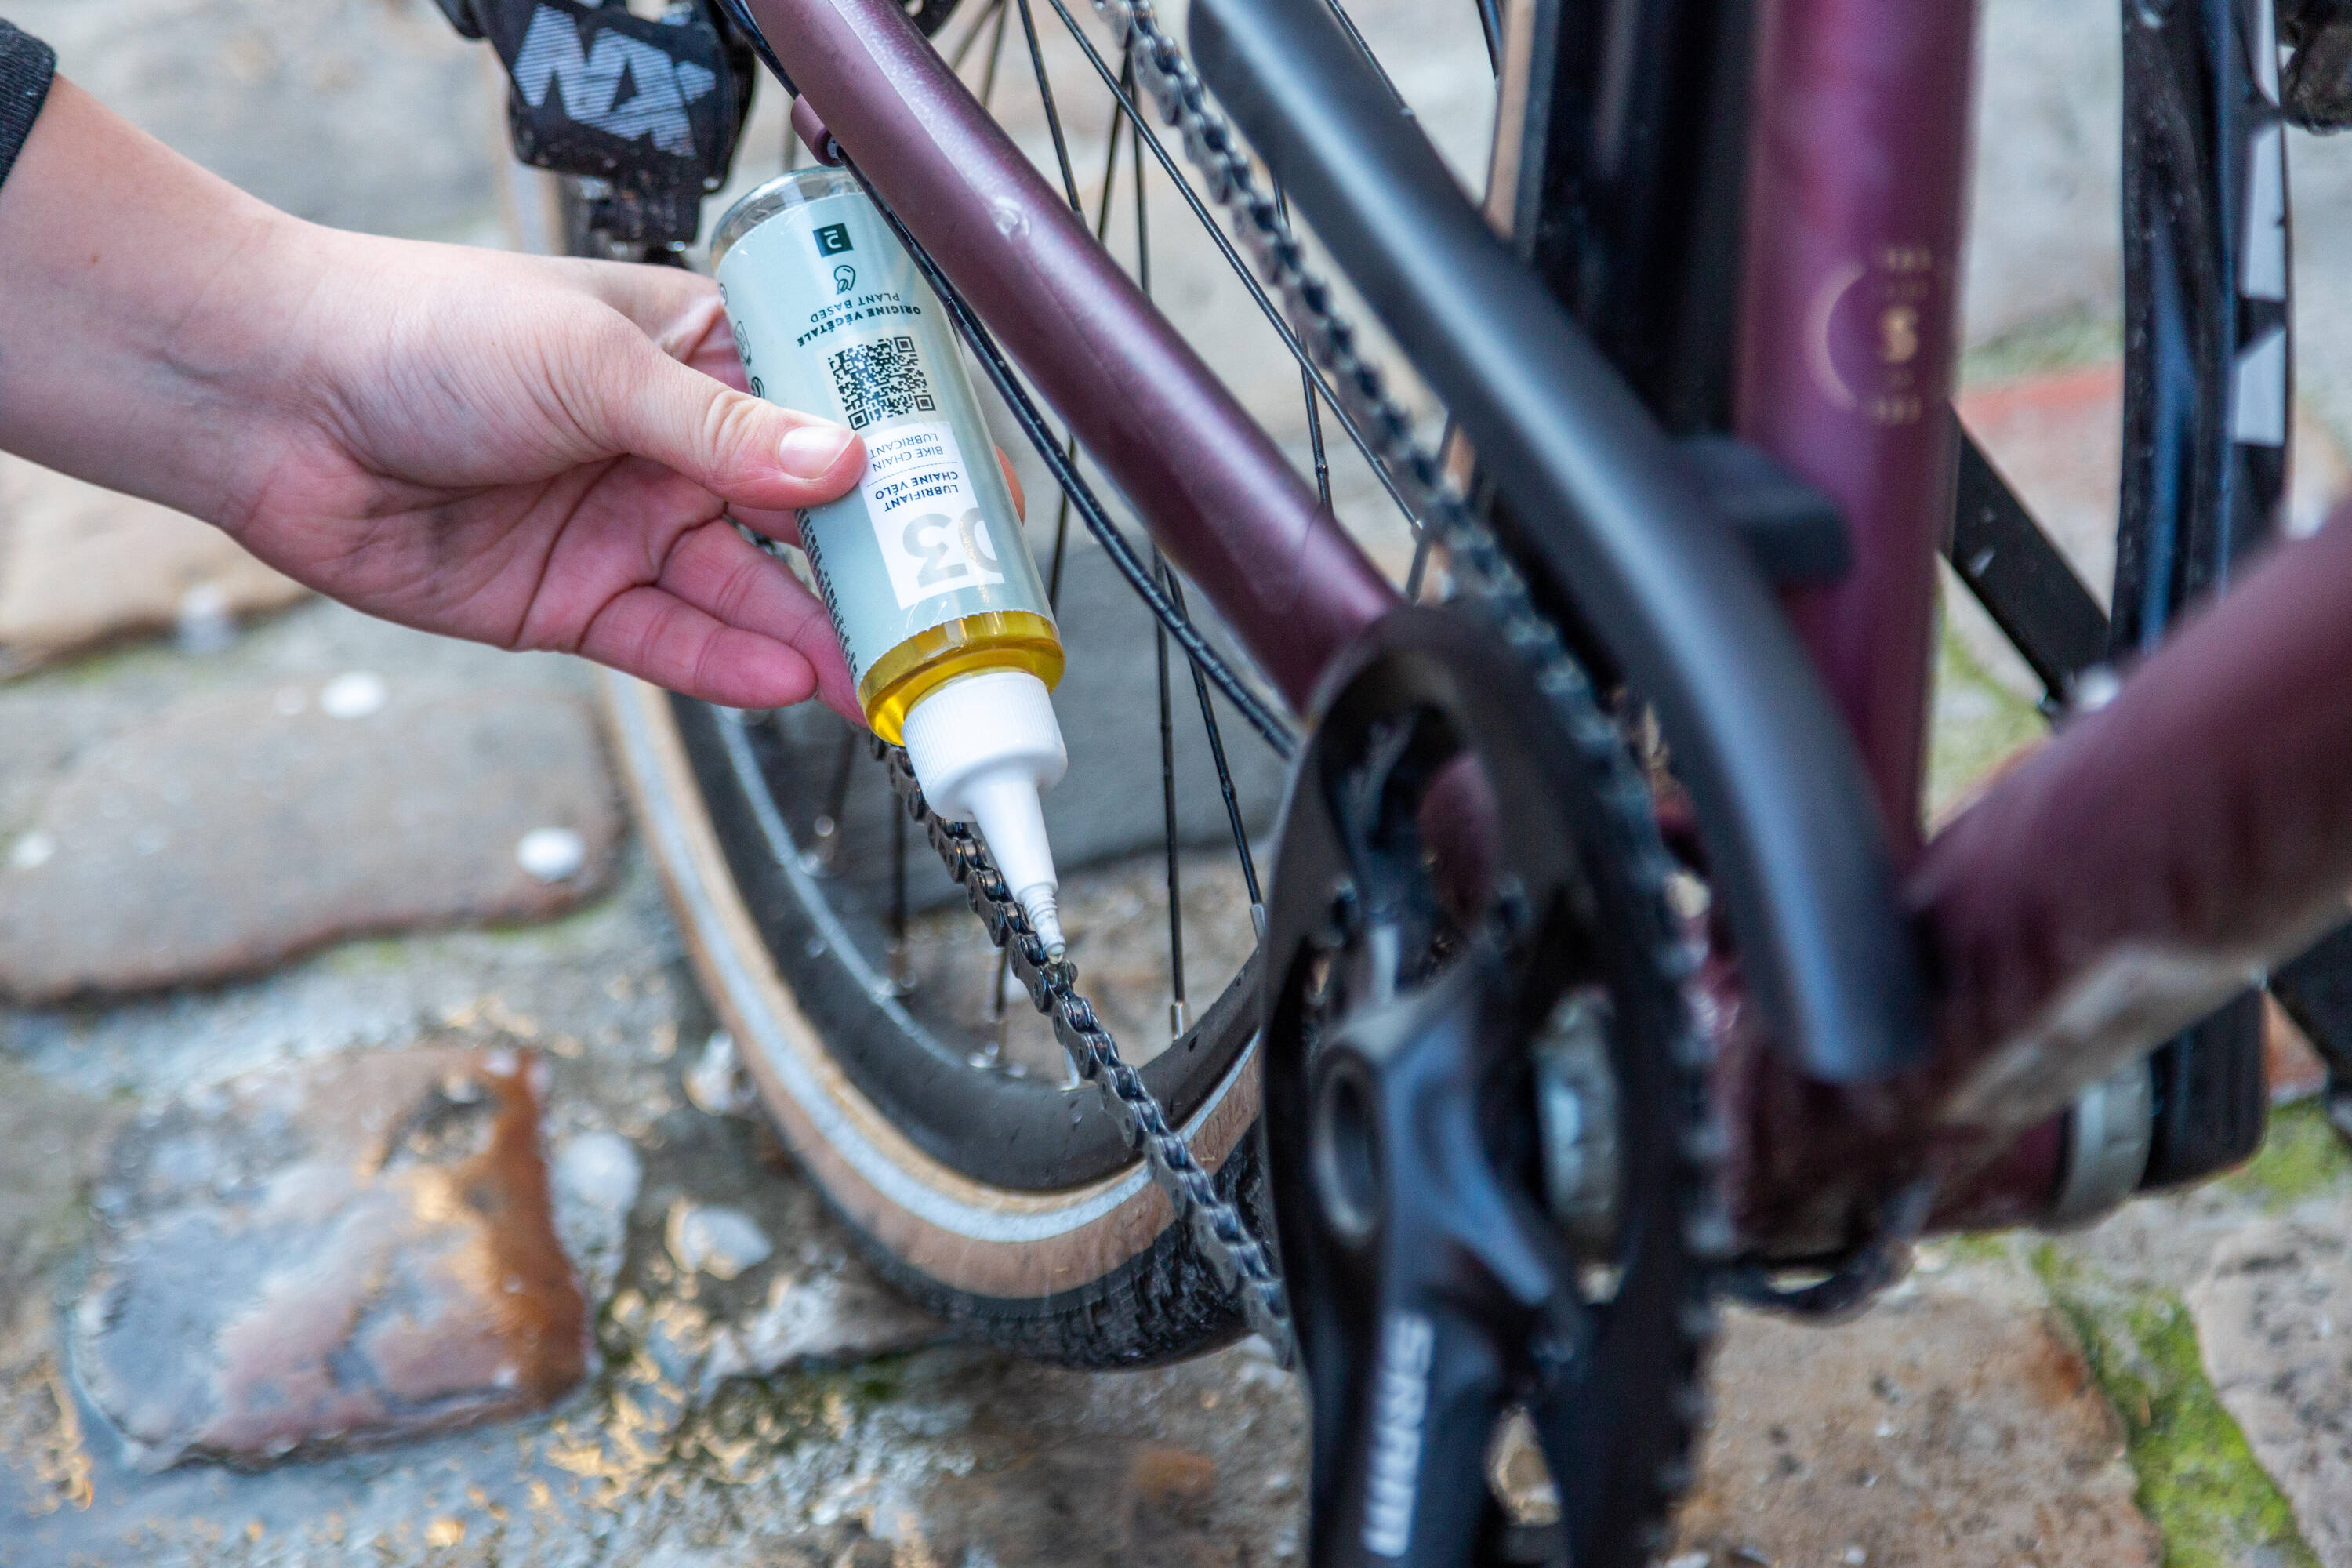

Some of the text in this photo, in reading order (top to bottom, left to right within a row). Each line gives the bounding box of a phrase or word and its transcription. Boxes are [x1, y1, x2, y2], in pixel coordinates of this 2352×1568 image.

[810, 292, 900, 323] PLANT BASED
[797, 306, 921, 347] ORIGINE VÉGÉTALE
[869, 432, 938, 459] LUBRICANT
[873, 445, 944, 472] BIKE CHAIN
[875, 470, 958, 500] CHAINE VÉLO
[884, 484, 959, 512] LUBRIFIANT
